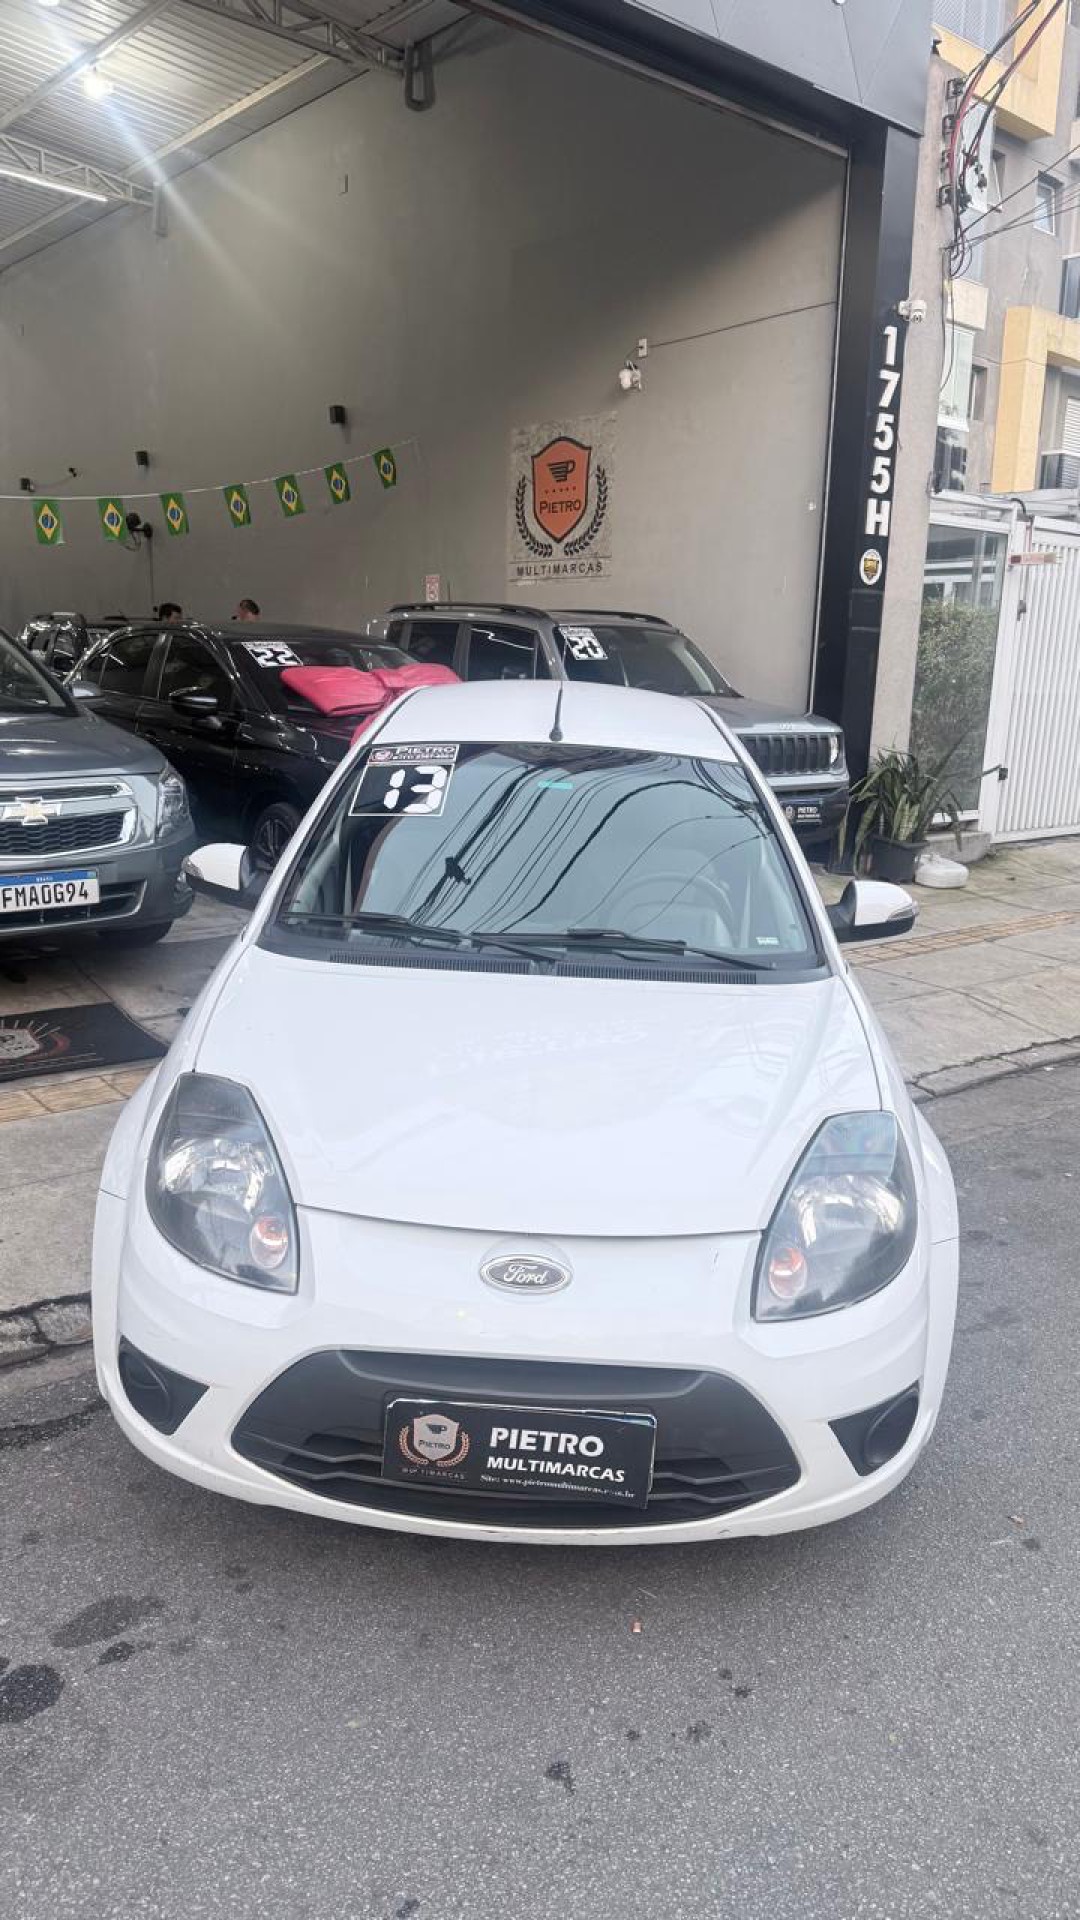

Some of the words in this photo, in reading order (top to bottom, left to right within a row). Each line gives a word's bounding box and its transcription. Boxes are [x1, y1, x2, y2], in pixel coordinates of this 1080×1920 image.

[864, 325, 900, 537] 1755H
[539, 500, 582, 514] PIETRO
[516, 562, 603, 577] MULTIMARCAS
[253, 649, 298, 667] 22
[569, 637, 604, 658] 20
[383, 765, 447, 814] 13
[503, 1264, 550, 1285] Ford
[418, 1439, 451, 1450] PIETRO
[489, 1426, 604, 1458] PIETRO
[486, 1455, 626, 1483] MULTIMARCAS
